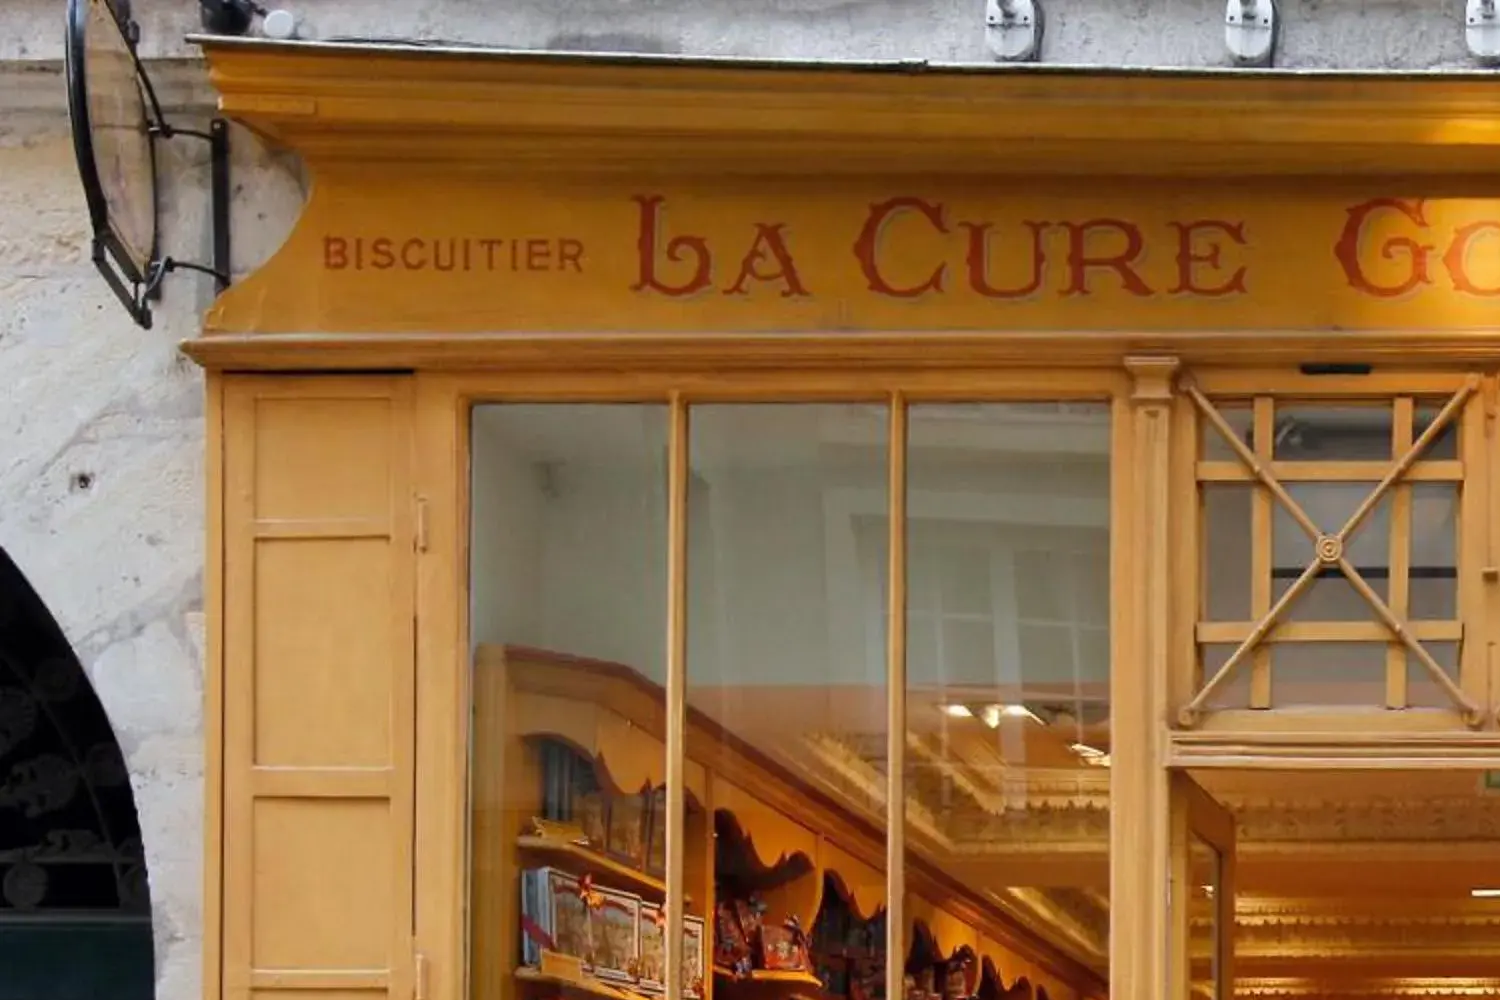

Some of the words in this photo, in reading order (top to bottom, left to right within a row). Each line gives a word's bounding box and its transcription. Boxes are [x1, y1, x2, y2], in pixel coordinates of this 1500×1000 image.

[322, 235, 584, 272] BISCUITIER
[631, 194, 810, 297] LA
[854, 196, 1249, 298] CURE
